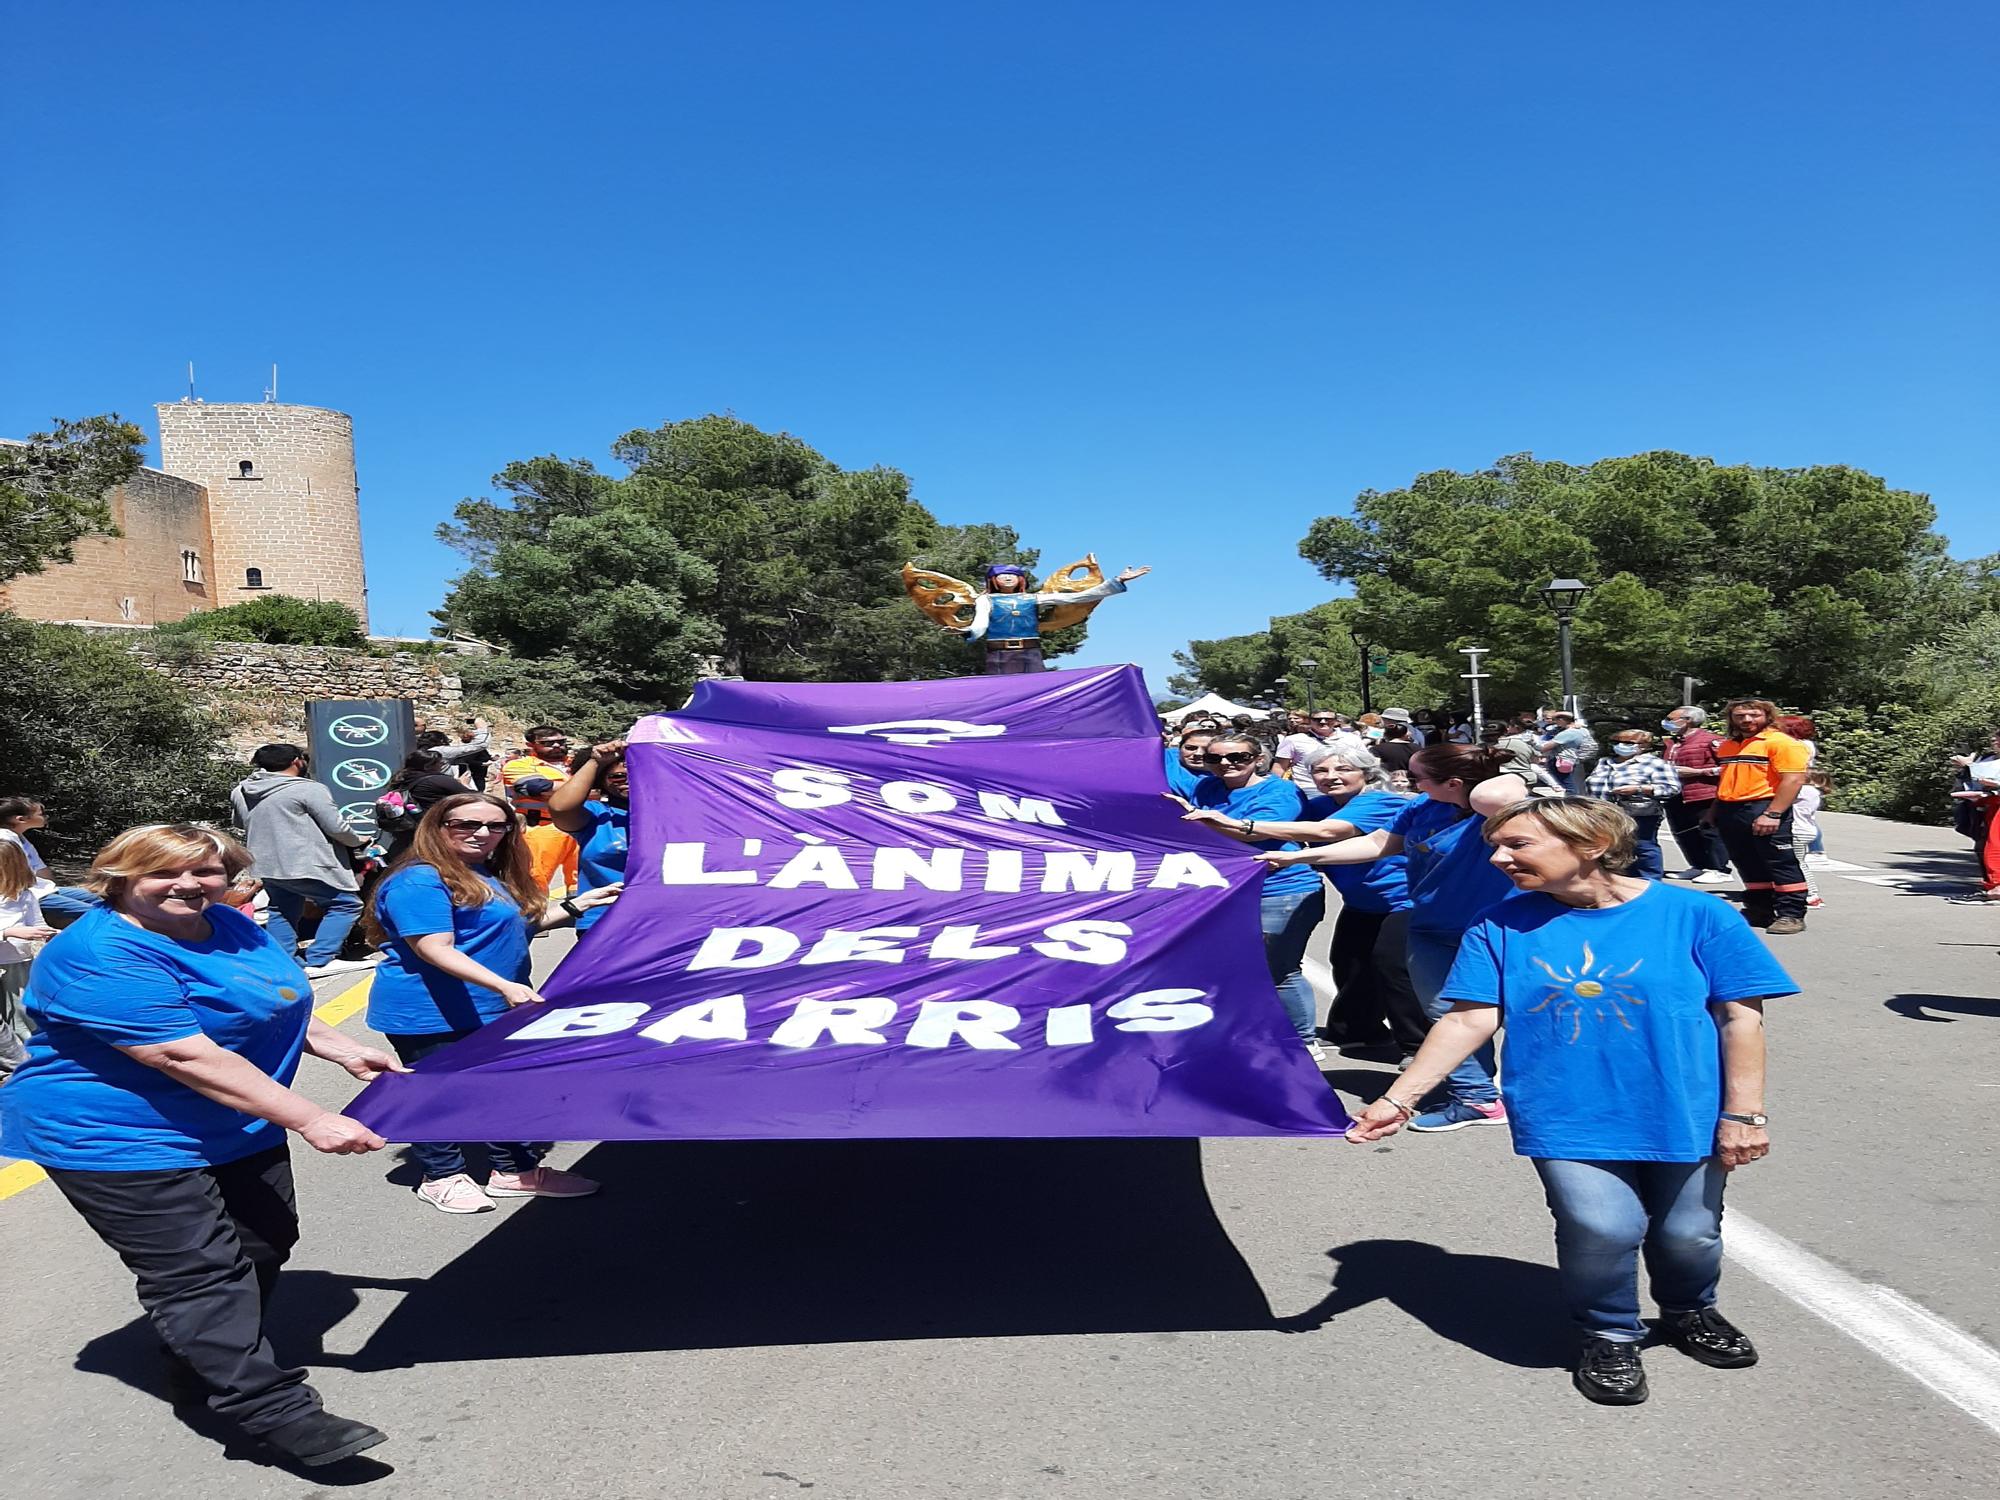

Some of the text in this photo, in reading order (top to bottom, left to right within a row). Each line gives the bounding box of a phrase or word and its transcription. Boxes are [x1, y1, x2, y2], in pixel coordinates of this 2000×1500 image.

[772, 769, 1067, 826] SOM
[662, 835, 1230, 892] L'ÀNIMA
[686, 920, 1133, 971] DELS
[505, 988, 1214, 1050] BARRIS
